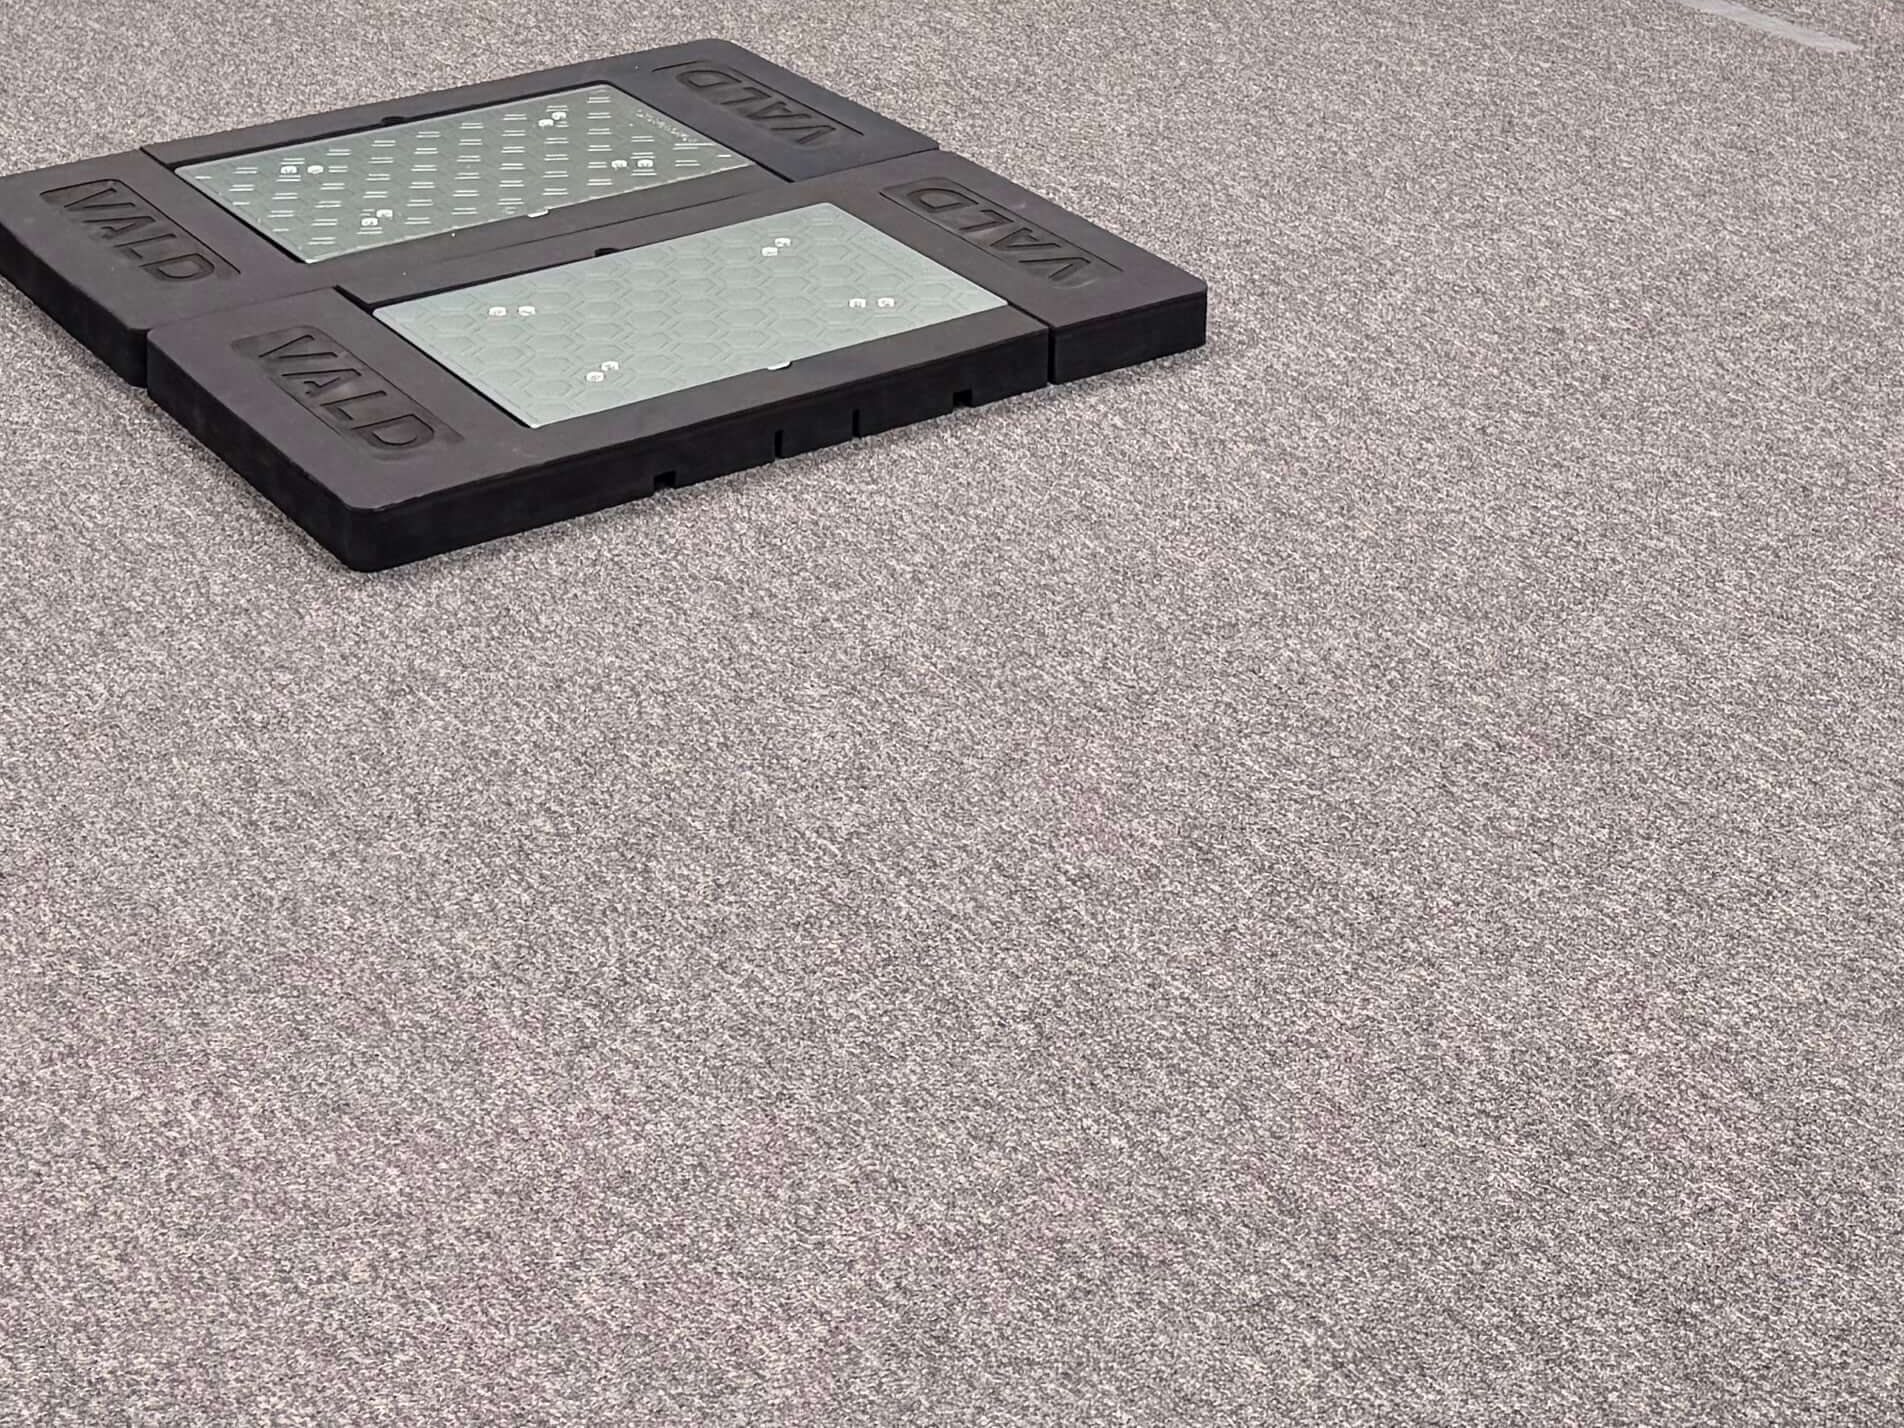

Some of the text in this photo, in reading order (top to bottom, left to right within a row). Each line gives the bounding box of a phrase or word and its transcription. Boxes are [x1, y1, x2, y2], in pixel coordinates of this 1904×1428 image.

[676, 68, 838, 145] VALD
[62, 186, 216, 281] VALD
[904, 186, 1092, 282] VALD
[257, 333, 436, 447] VALD
